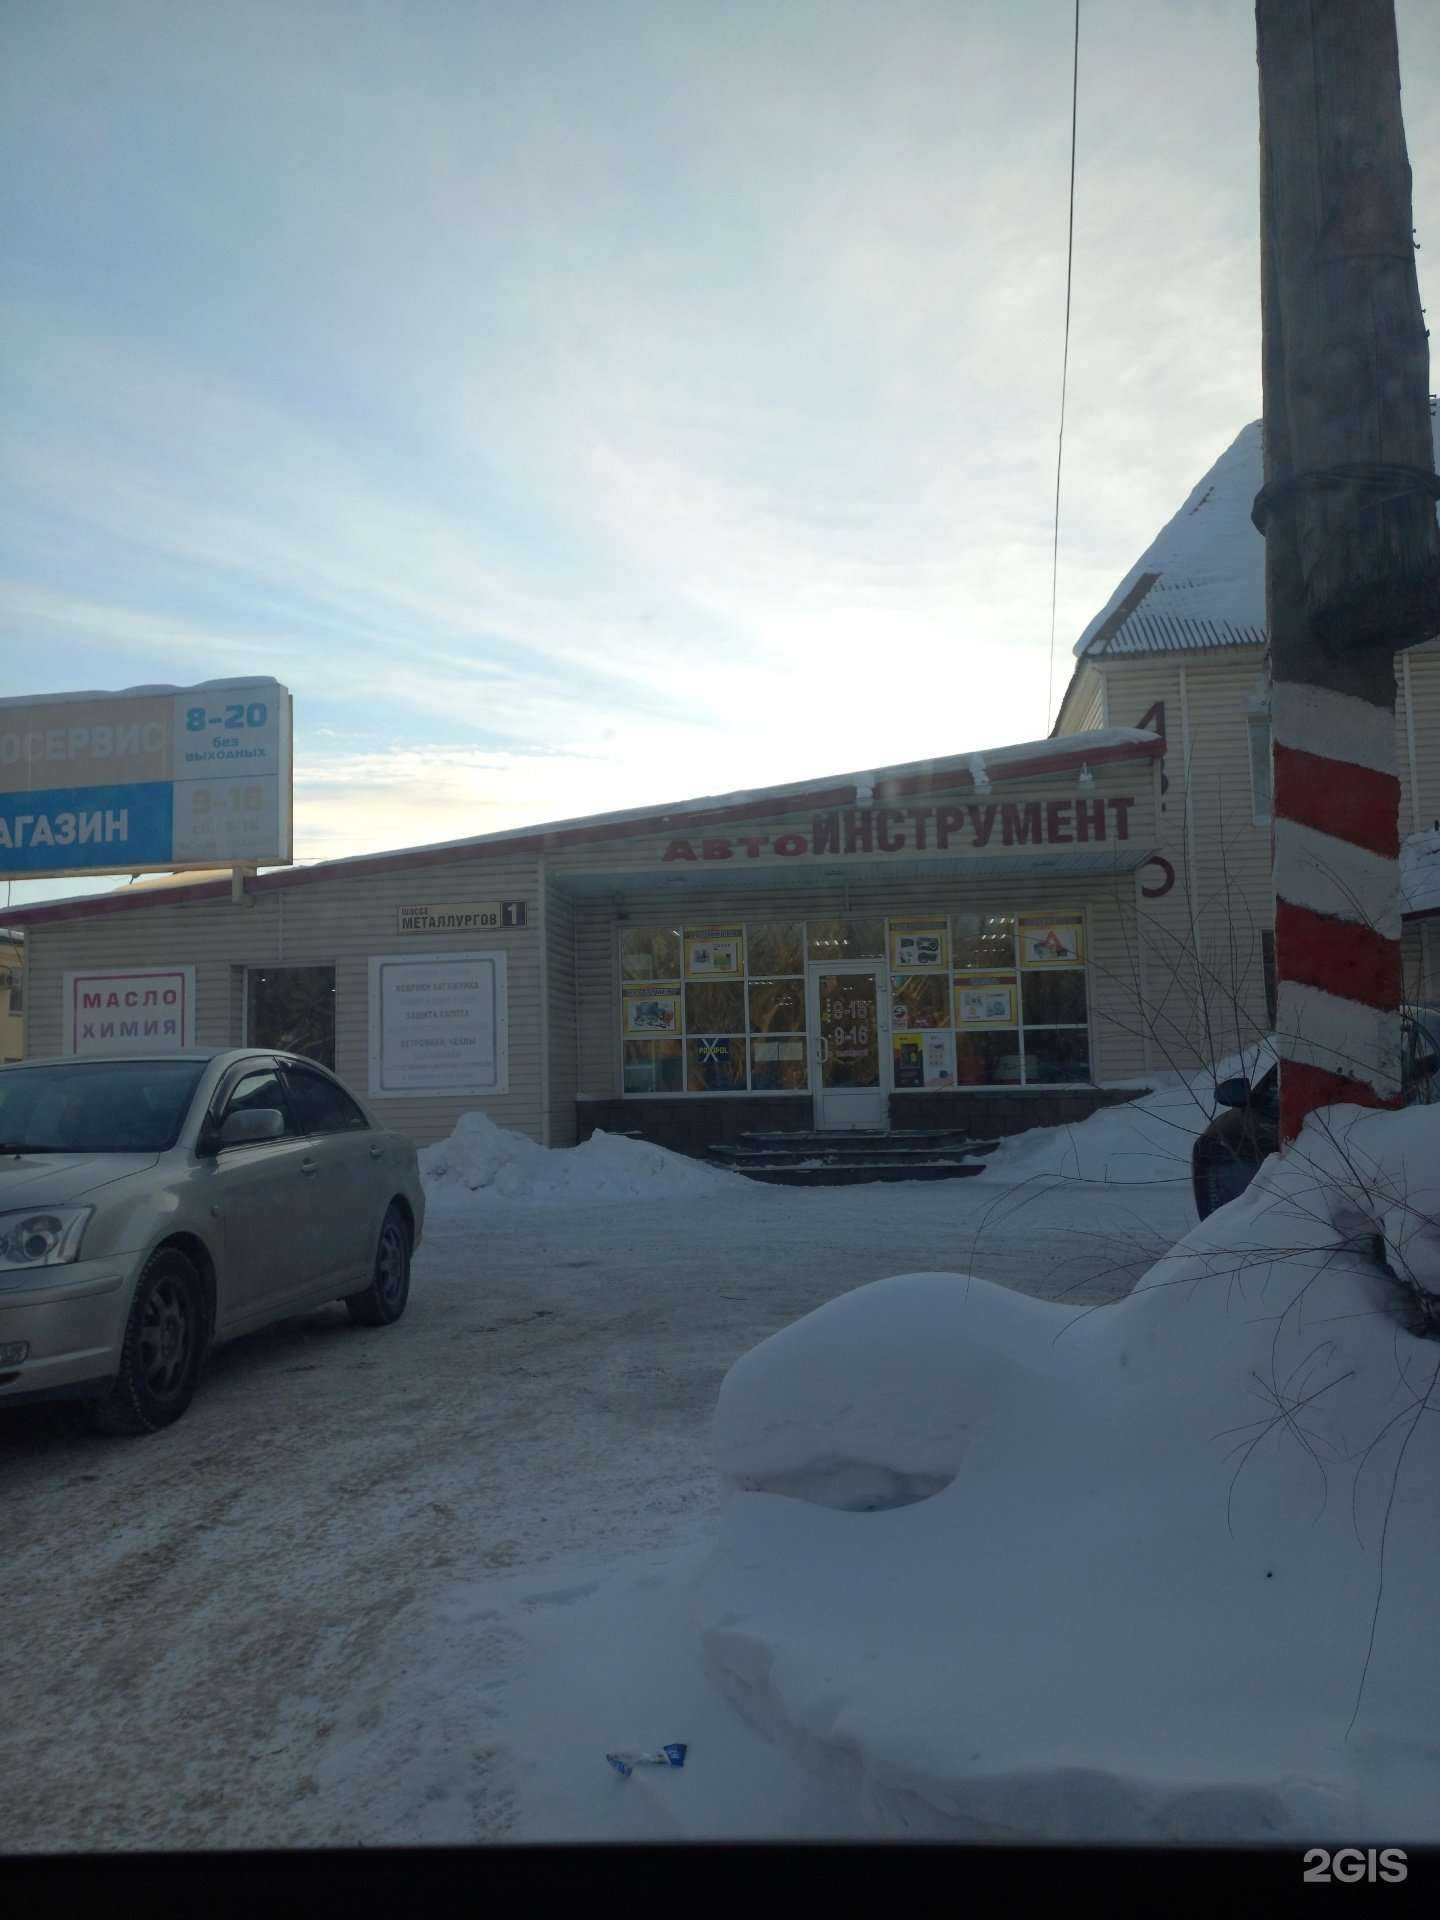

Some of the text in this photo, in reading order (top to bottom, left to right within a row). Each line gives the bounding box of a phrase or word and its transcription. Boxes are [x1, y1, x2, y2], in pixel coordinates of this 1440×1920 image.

[185, 702, 268, 732] 8-20
[212, 735, 240, 749] без
[401, 903, 518, 929] МЕТАЛЛУРГОВ 1
[82, 989, 177, 1009] МАСЛО
[82, 1019, 177, 1039] ХИМИЯ
